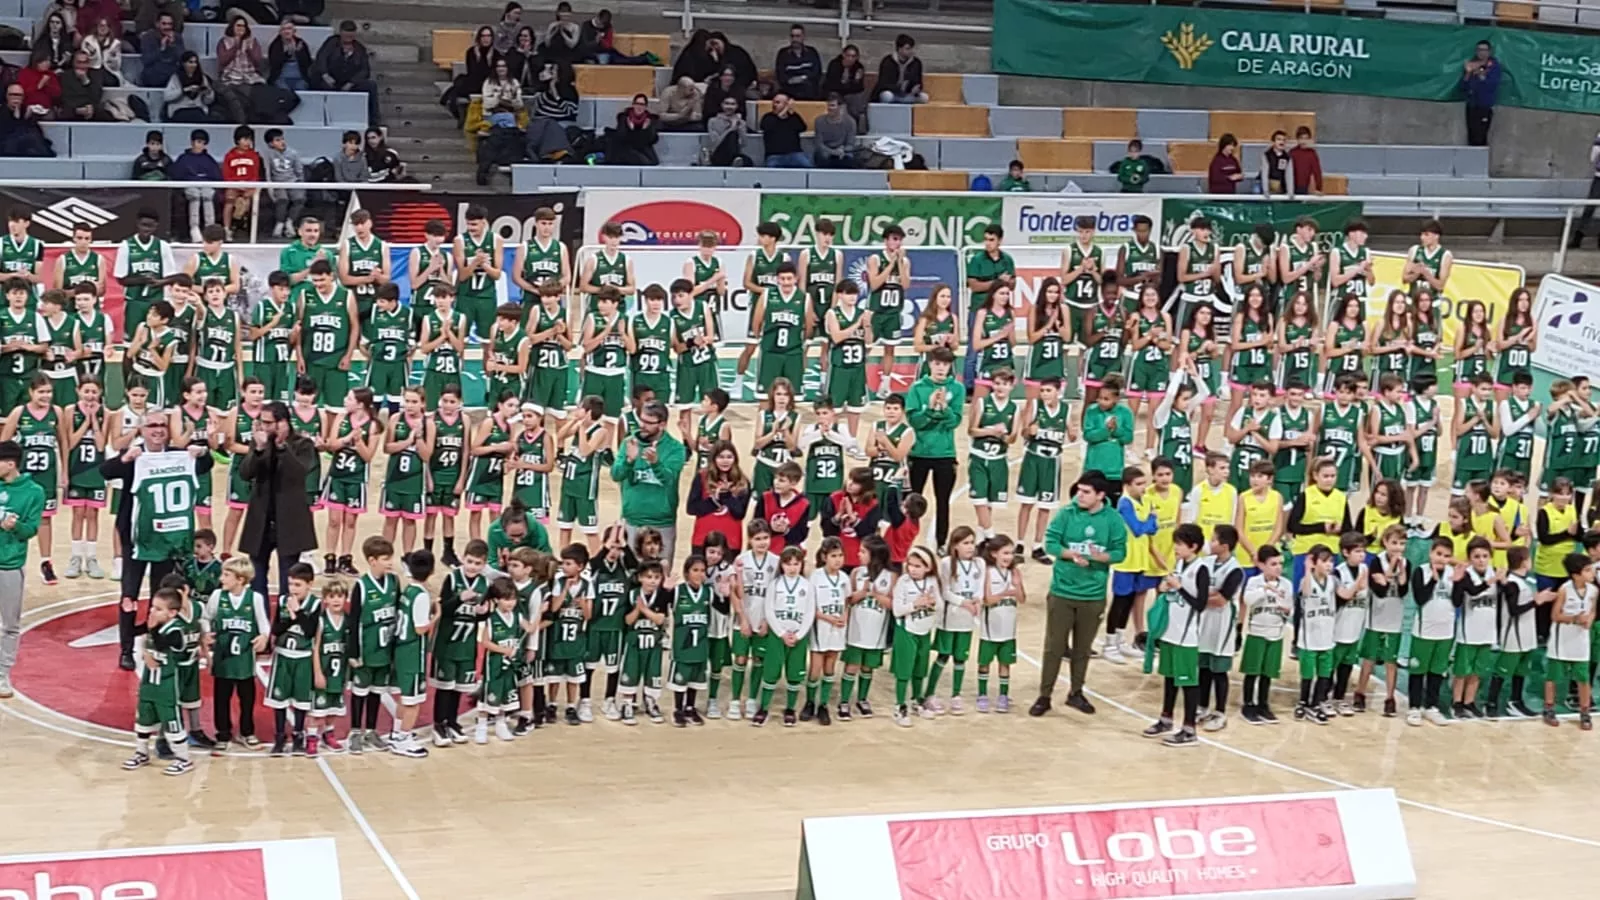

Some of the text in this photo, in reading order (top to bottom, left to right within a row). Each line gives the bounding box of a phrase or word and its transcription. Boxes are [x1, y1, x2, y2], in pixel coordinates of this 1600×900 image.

[1220, 28, 1369, 60] CAJA RURAL
[1237, 57, 1352, 80] DE ARAGÓN
[471, 272, 484, 289] 17
[1076, 280, 1093, 297] 14
[880, 290, 899, 306] 00
[313, 331, 335, 353] 88
[777, 328, 788, 347] 8
[384, 345, 396, 361] 3
[538, 349, 559, 368] 20
[842, 345, 863, 364] 33
[992, 343, 1008, 359] 33
[1043, 342, 1058, 358] 31
[1250, 349, 1265, 364] 16
[1509, 349, 1527, 366] 00
[12, 356, 24, 373] 3
[606, 351, 617, 368] 2
[640, 354, 659, 371] 99
[1295, 353, 1308, 368] 15
[1343, 355, 1358, 370] 13
[1475, 360, 1483, 374] 5
[80, 445, 95, 462] 13
[1470, 436, 1486, 454] 10
[1516, 440, 1531, 458] 31
[26, 452, 49, 471] 23
[336, 453, 356, 472] 34
[400, 456, 410, 472] 8
[439, 452, 458, 466] 49
[816, 460, 837, 478] 32
[516, 471, 534, 485] 28
[147, 480, 190, 514] 10
[602, 598, 618, 616] 17
[451, 622, 474, 642] 77
[562, 624, 577, 641] 13
[691, 629, 699, 646] 1
[230, 636, 241, 655] 6
[638, 634, 655, 650] 10
[331, 659, 340, 677] 9
[986, 816, 1257, 866] GRUPO Lobe
[1091, 865, 1245, 886] HIGH QUALITY HOMES
